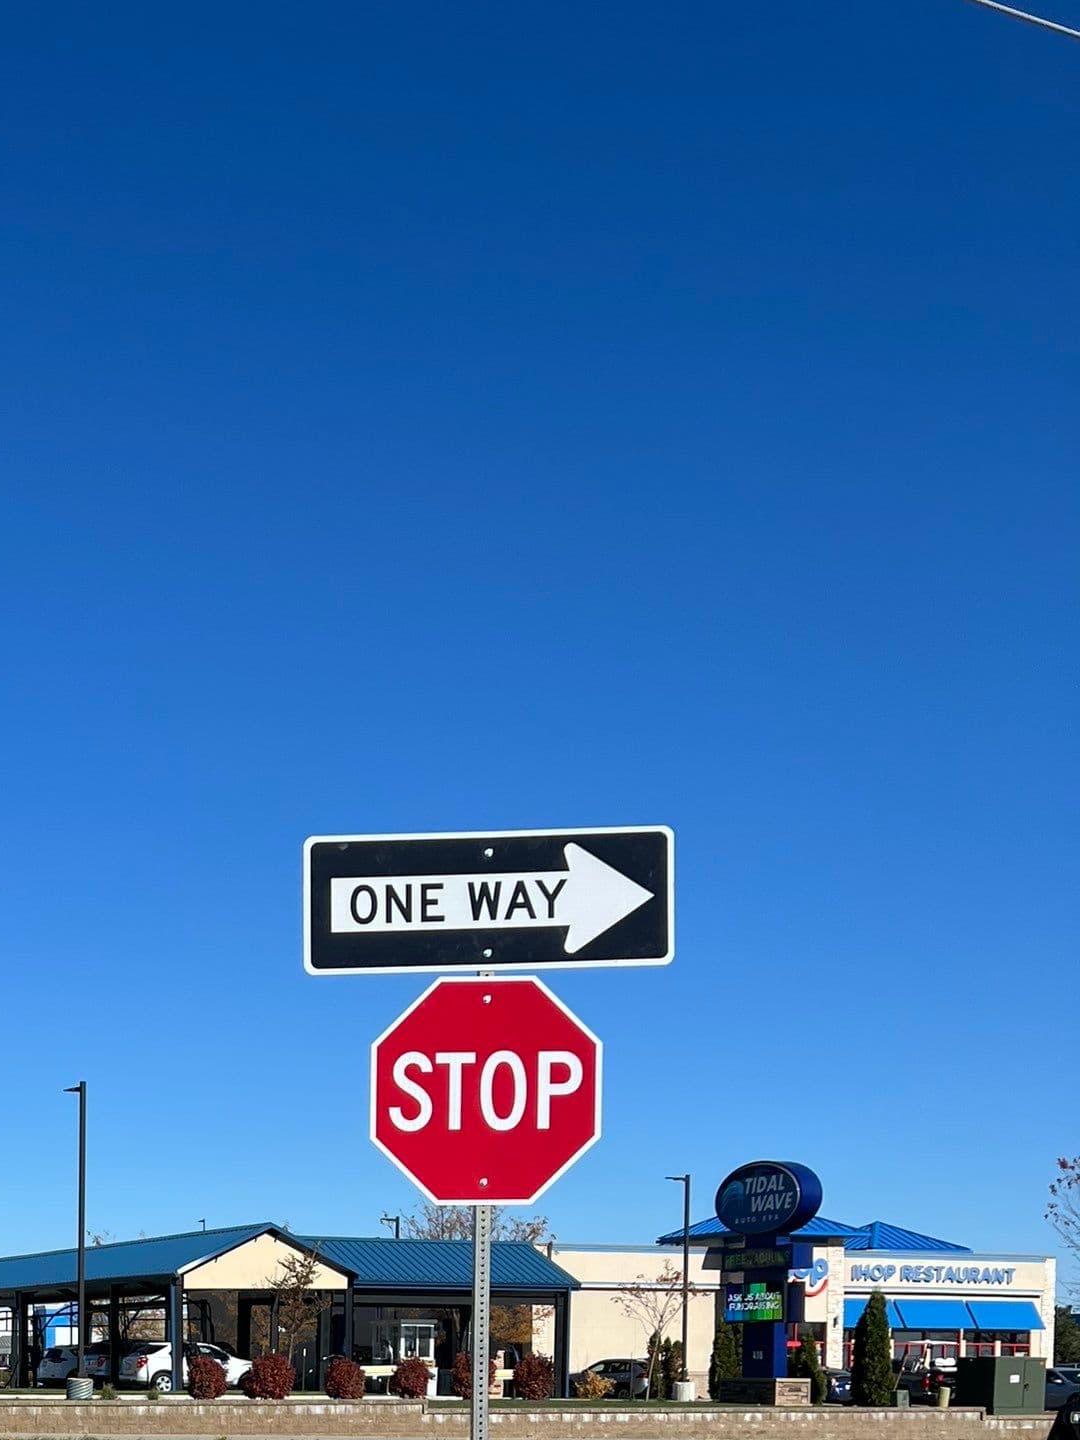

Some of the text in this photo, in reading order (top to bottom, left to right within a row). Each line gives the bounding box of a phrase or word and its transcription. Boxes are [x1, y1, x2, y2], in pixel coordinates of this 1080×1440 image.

[350, 878, 567, 925] ONE WAY
[388, 1050, 584, 1132] STOP
[745, 1174, 785, 1195] TIDAL
[751, 1191, 793, 1212] WAVE
[851, 1264, 1016, 1285] IHOP RESTAURANT
[728, 1293, 742, 1302] ASK
